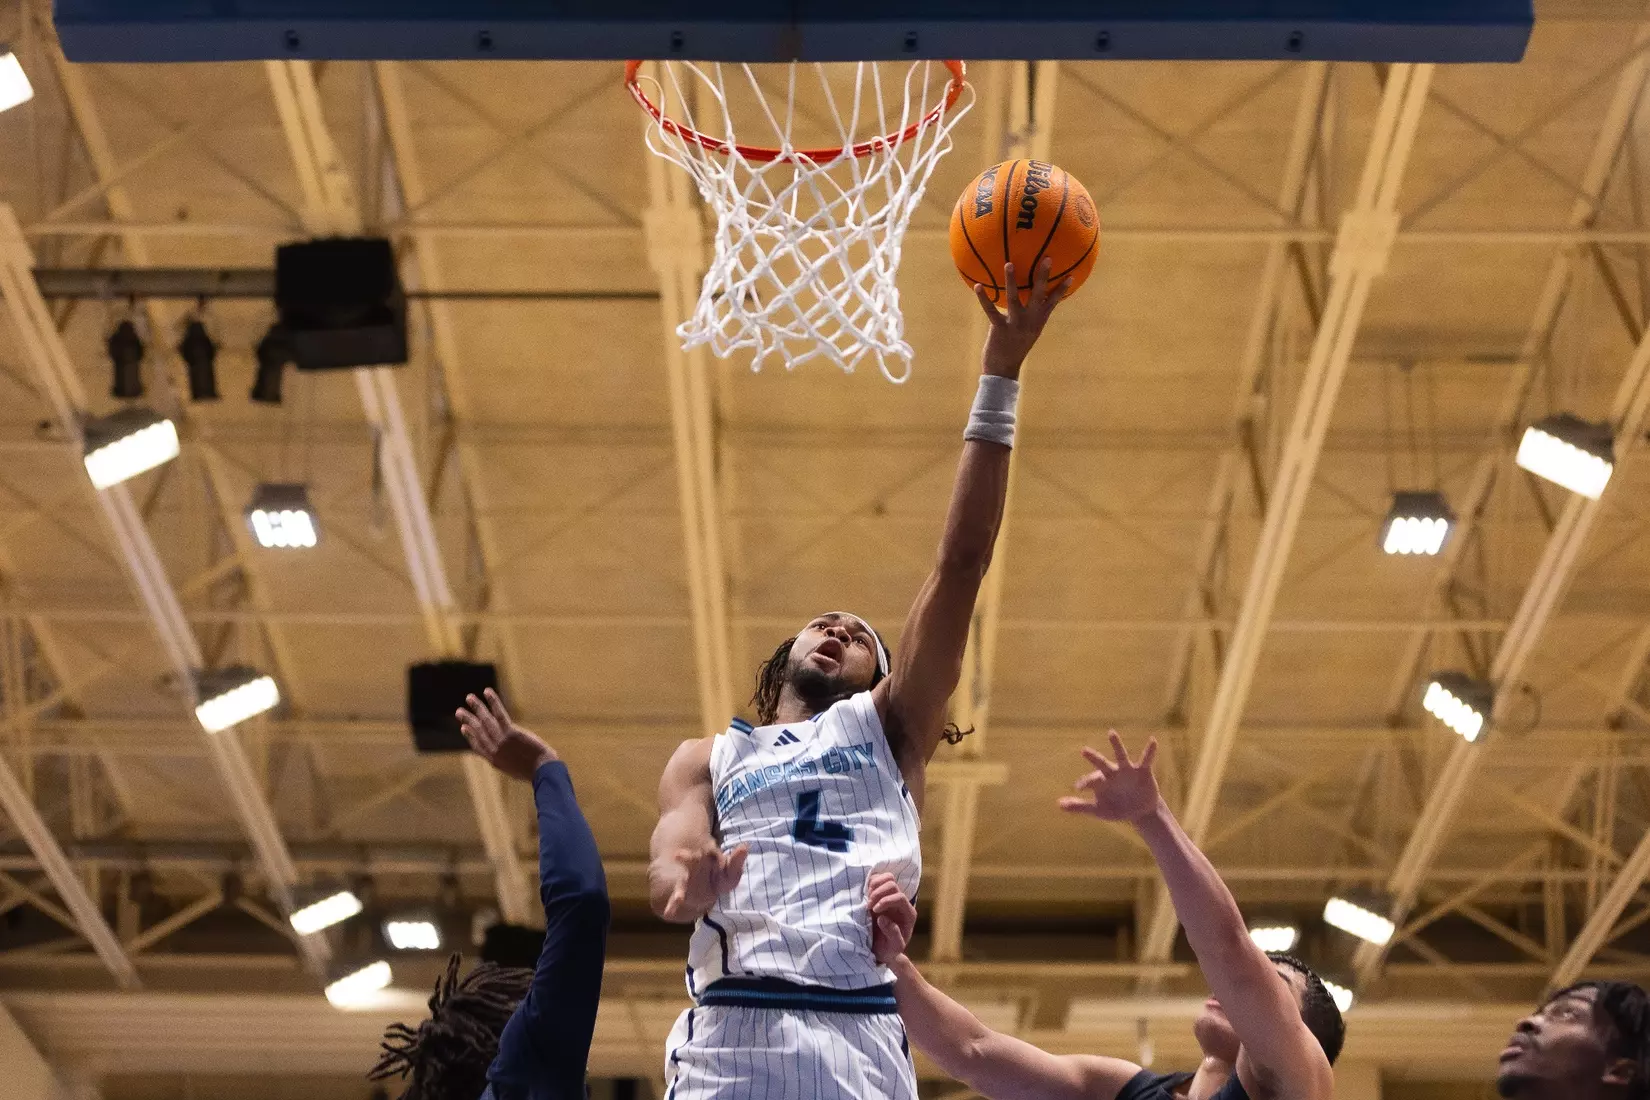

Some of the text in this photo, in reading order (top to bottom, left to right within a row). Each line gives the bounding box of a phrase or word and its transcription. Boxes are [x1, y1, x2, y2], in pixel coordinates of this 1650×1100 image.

[717, 742, 877, 812] KANSAS CITY
[793, 790, 854, 852] 4
